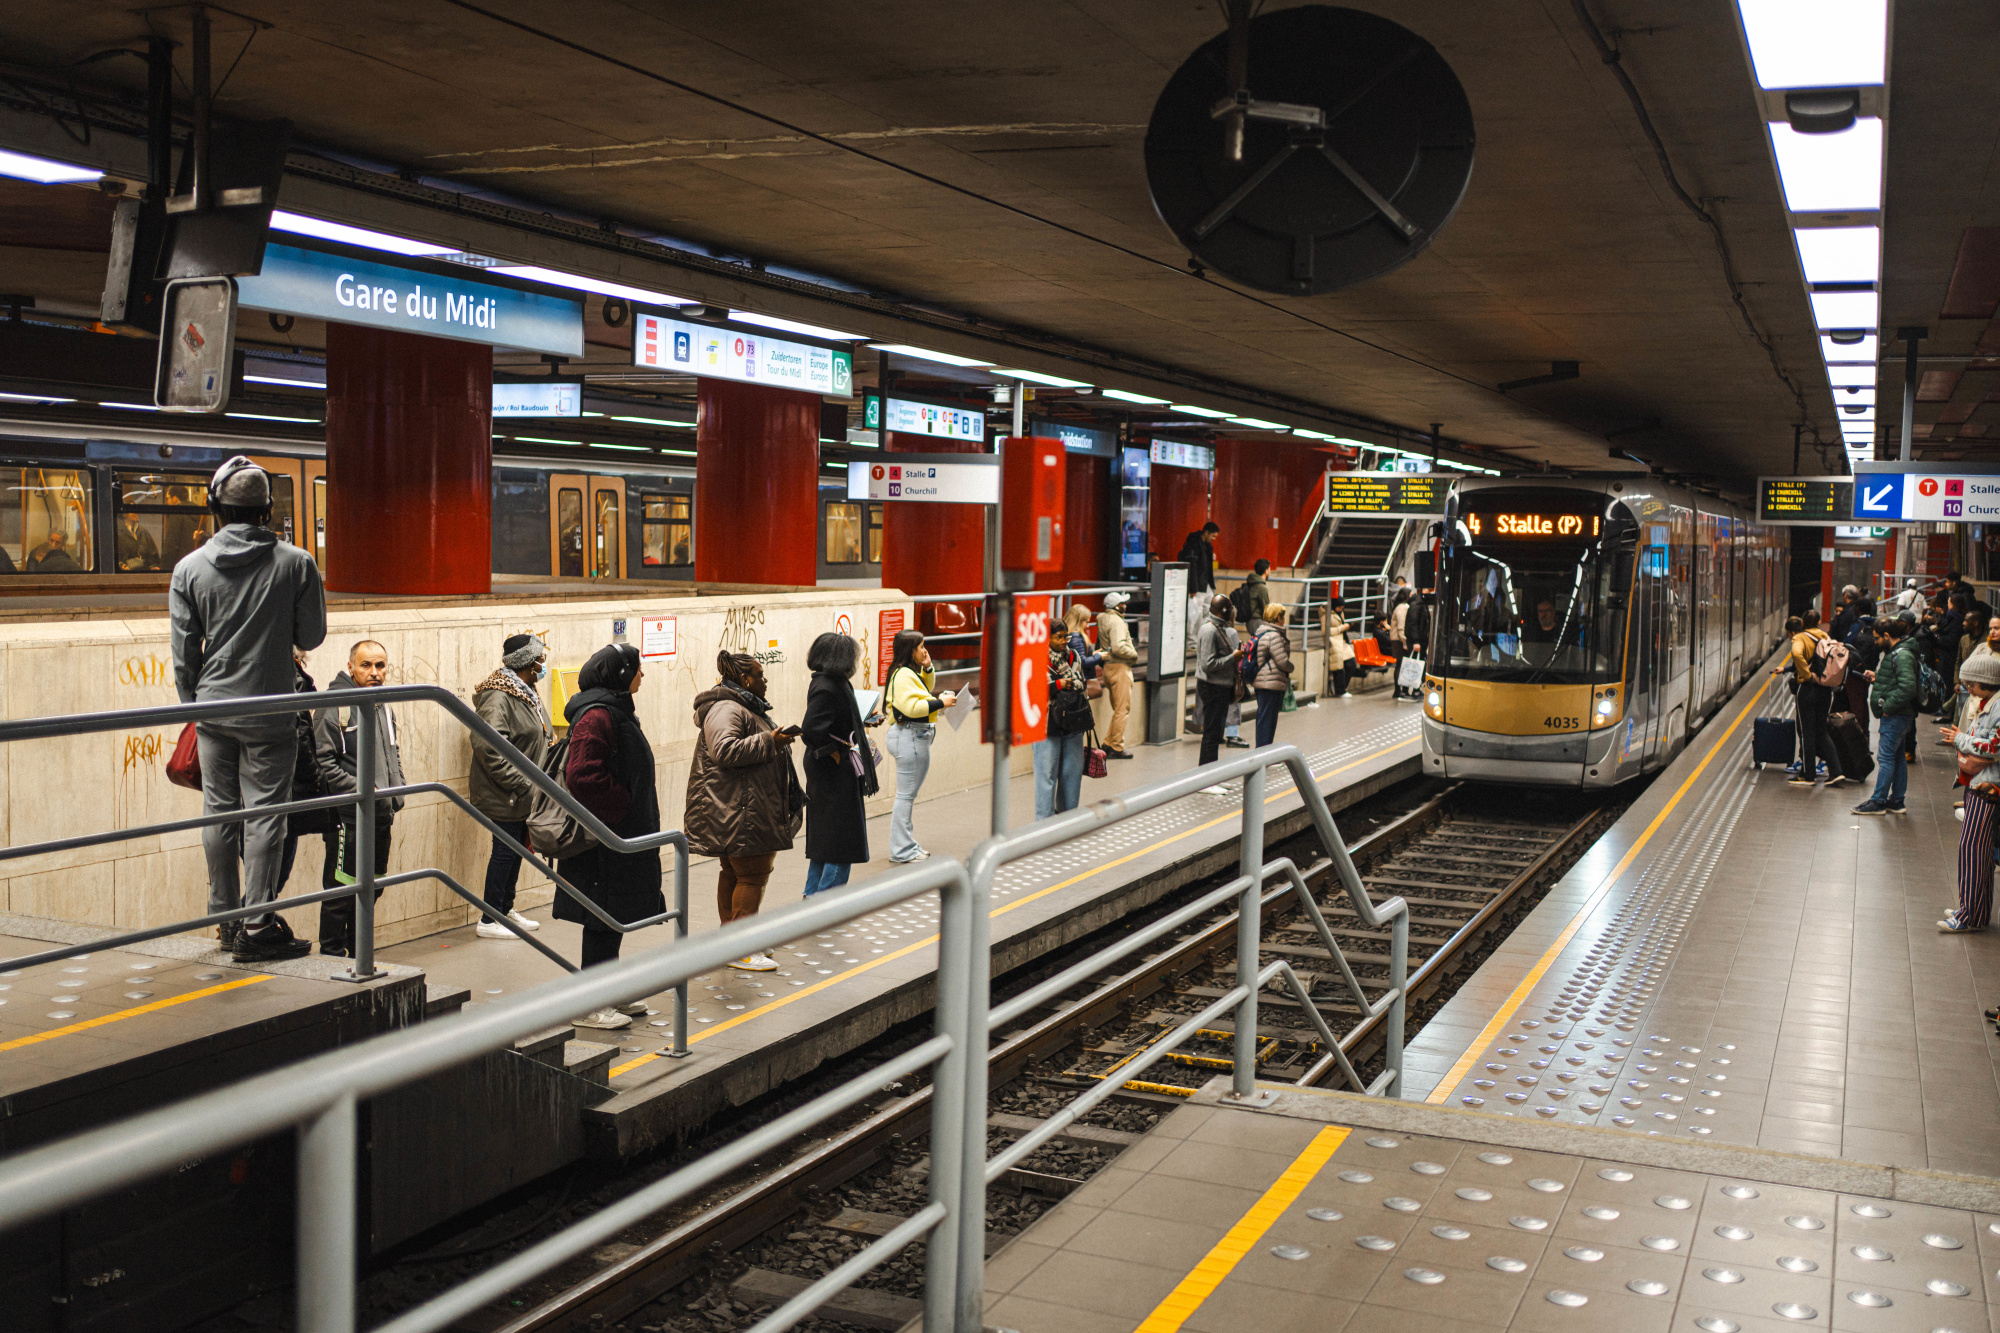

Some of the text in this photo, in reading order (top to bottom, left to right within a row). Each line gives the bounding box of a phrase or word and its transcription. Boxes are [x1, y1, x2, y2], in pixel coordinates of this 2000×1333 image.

[335, 274, 496, 329] Gare du Midi
[747, 344, 755, 355] 73
[771, 350, 802, 365] Zuidertoren
[767, 364, 779, 375] Tour
[780, 366, 788, 376] du
[510, 403, 519, 411] Roi
[521, 403, 549, 411] Baudouin
[875, 468, 881, 478] T
[891, 469, 898, 477] 4
[906, 470, 926, 478] Stalle
[890, 486, 937, 495] 10 Churchill
[1923, 481, 2000, 494] T 4 Stalle
[1946, 503, 1960, 513] 10
[1469, 513, 1582, 535] 4 Stalle (P)
[1017, 612, 1047, 647] SOS
[1543, 716, 1579, 729] 4035
